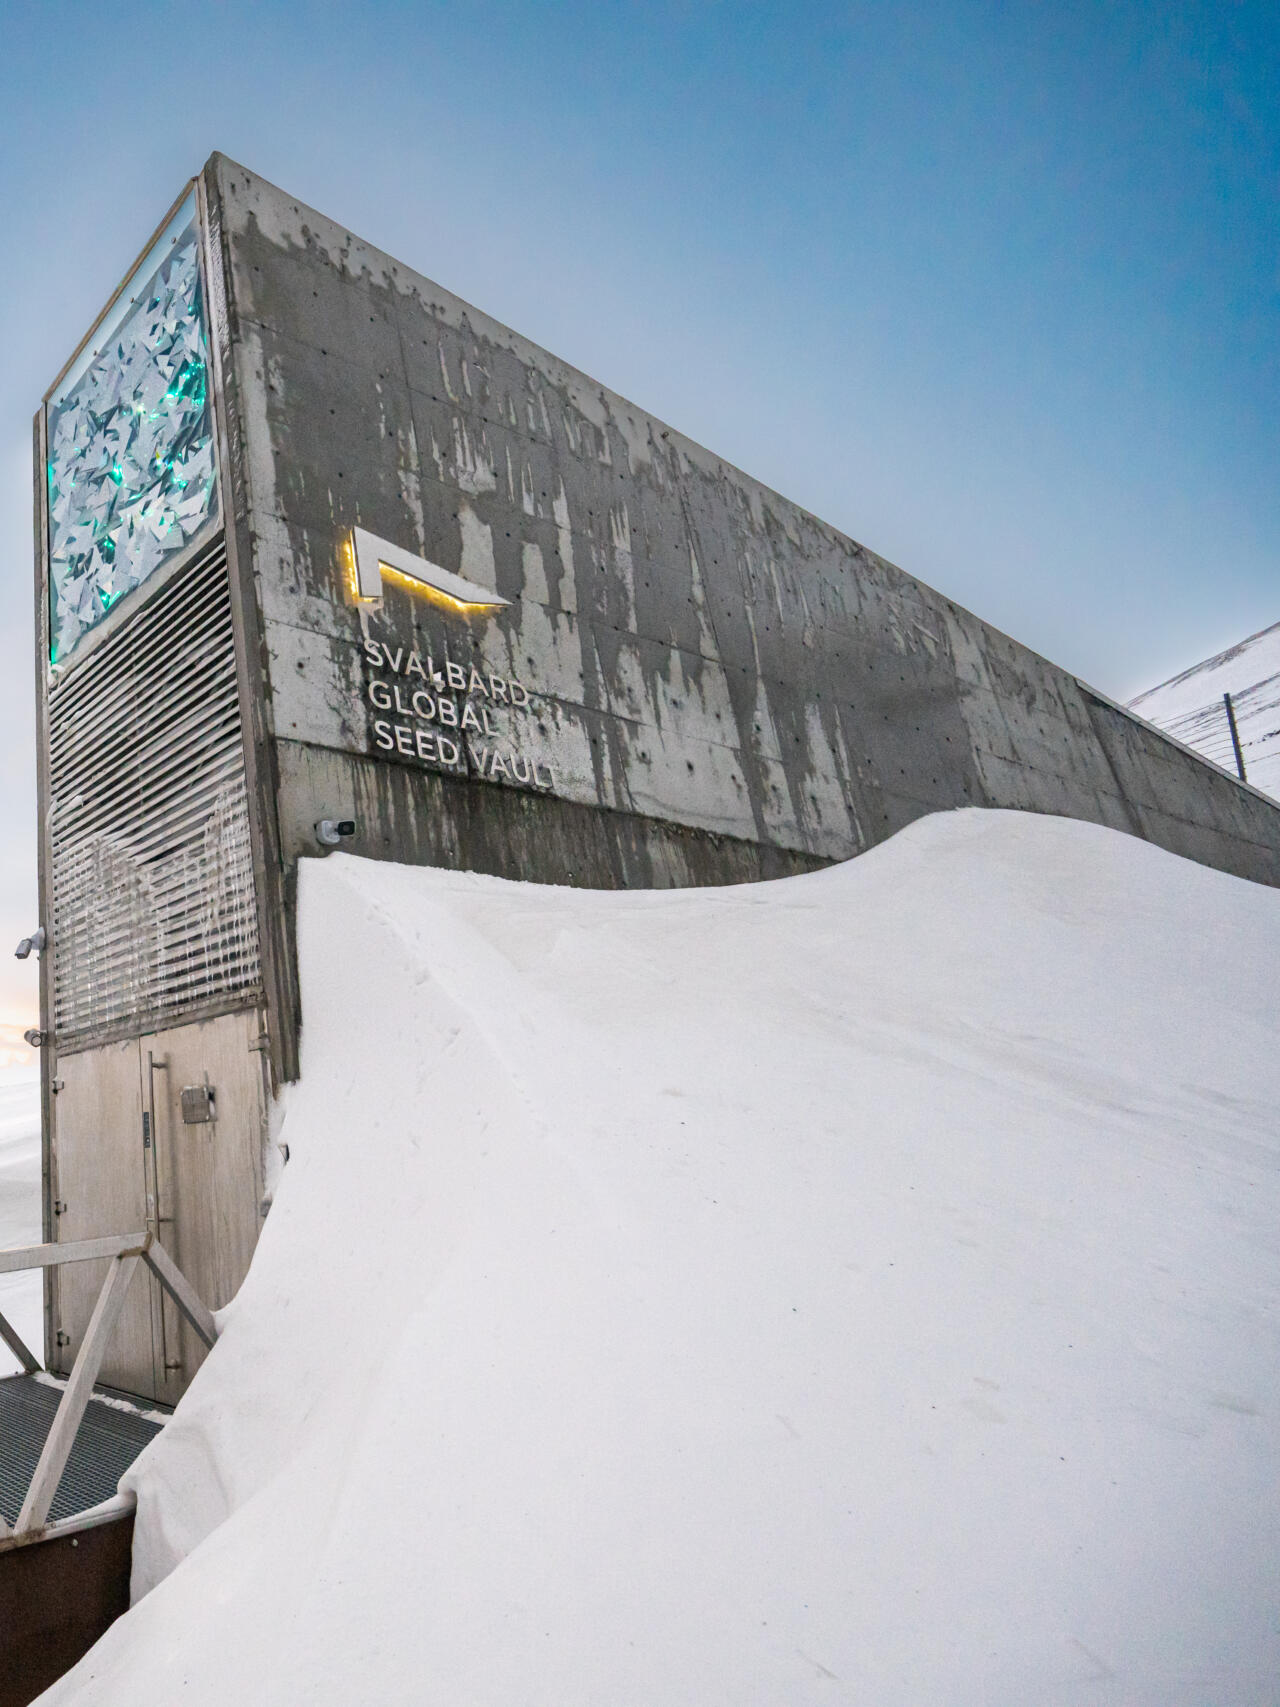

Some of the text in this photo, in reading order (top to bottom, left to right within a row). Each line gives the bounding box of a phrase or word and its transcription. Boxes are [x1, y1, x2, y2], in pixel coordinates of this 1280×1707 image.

[363, 639, 529, 706] SVALBARD
[368, 680, 501, 737] GLOBAL
[374, 720, 459, 765] SEED
